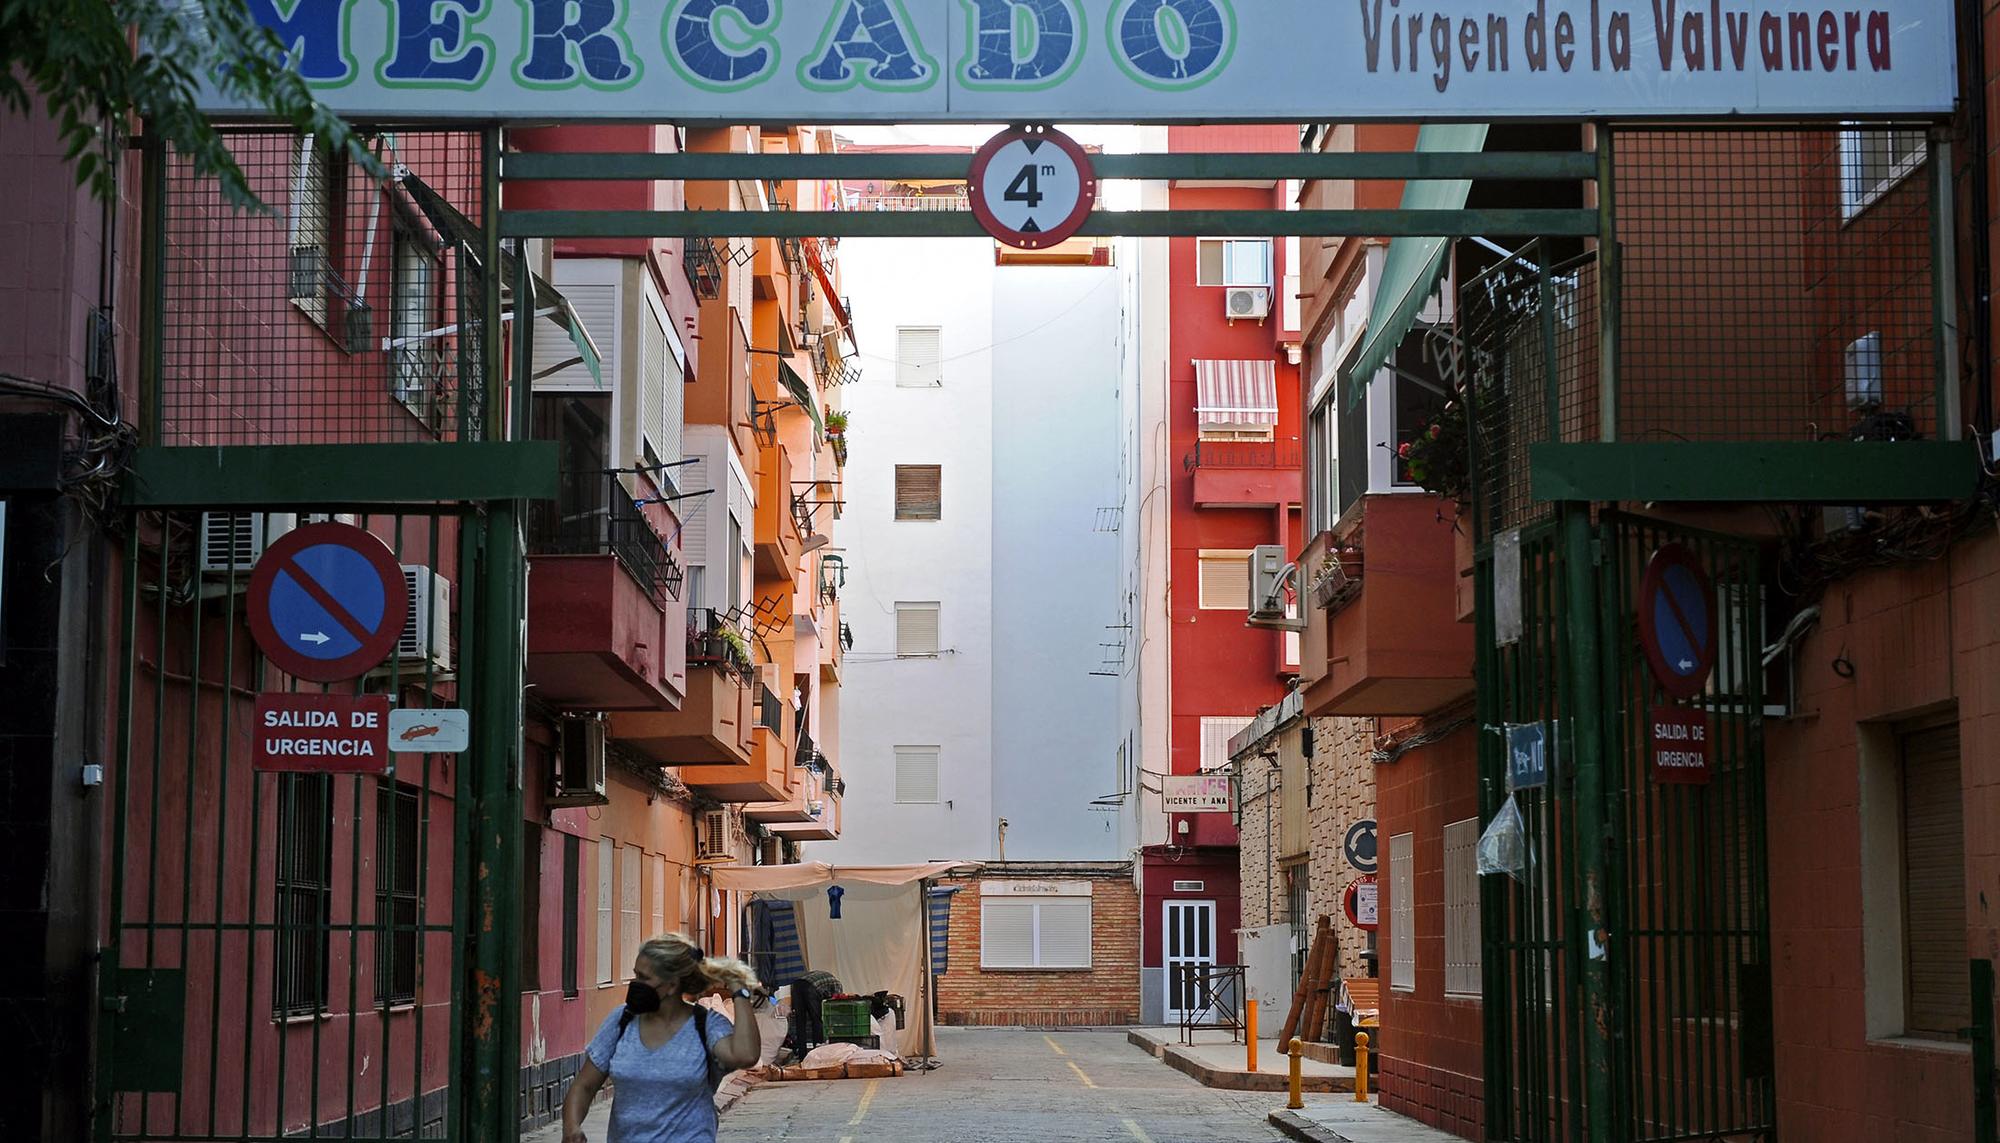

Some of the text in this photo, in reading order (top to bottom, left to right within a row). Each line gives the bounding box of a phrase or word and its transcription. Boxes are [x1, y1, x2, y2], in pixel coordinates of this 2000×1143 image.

[207, 0, 1238, 92] MERCADO
[1360, 0, 1892, 93] Virgen de la Valvanera
[264, 710, 378, 728] SALIDA DE
[1654, 723, 1704, 741] SALIDA DE
[265, 738, 374, 756] URGENCIA
[1656, 751, 1704, 768] URGENCIA
[1165, 797, 1227, 805] VICENTE Y ANA
